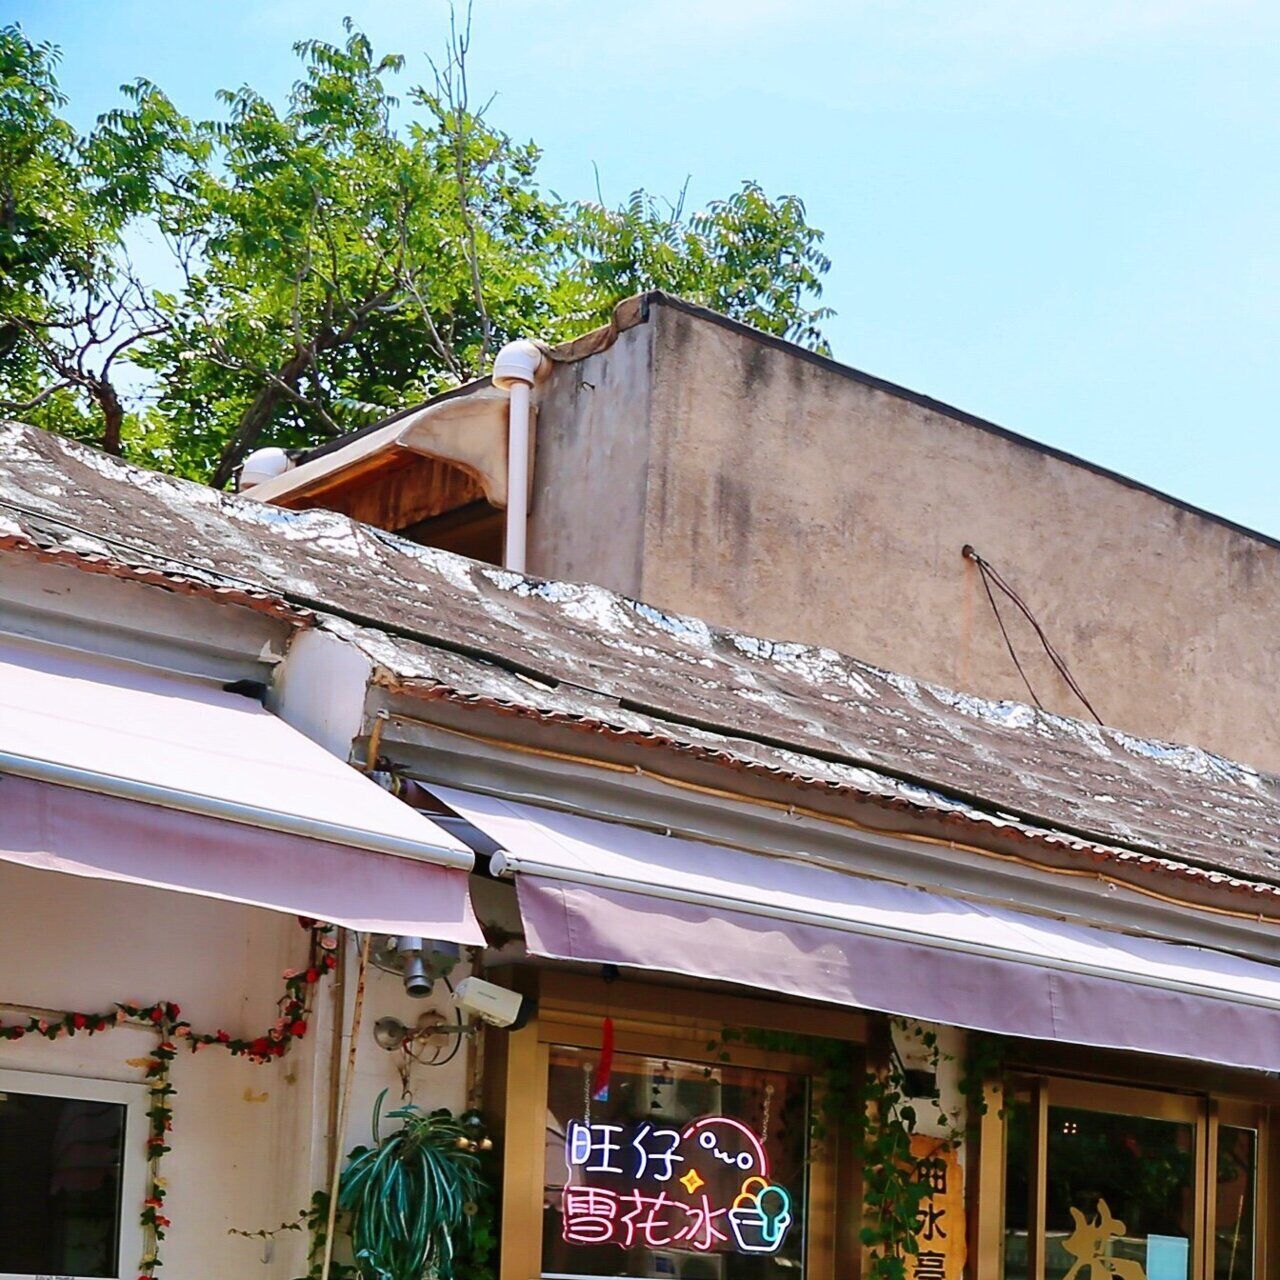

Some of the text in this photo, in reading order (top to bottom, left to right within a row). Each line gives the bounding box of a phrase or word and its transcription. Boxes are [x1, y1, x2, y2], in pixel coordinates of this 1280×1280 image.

[571, 1123, 684, 1181] 旺仔
[567, 1186, 729, 1249] 雪花冰
